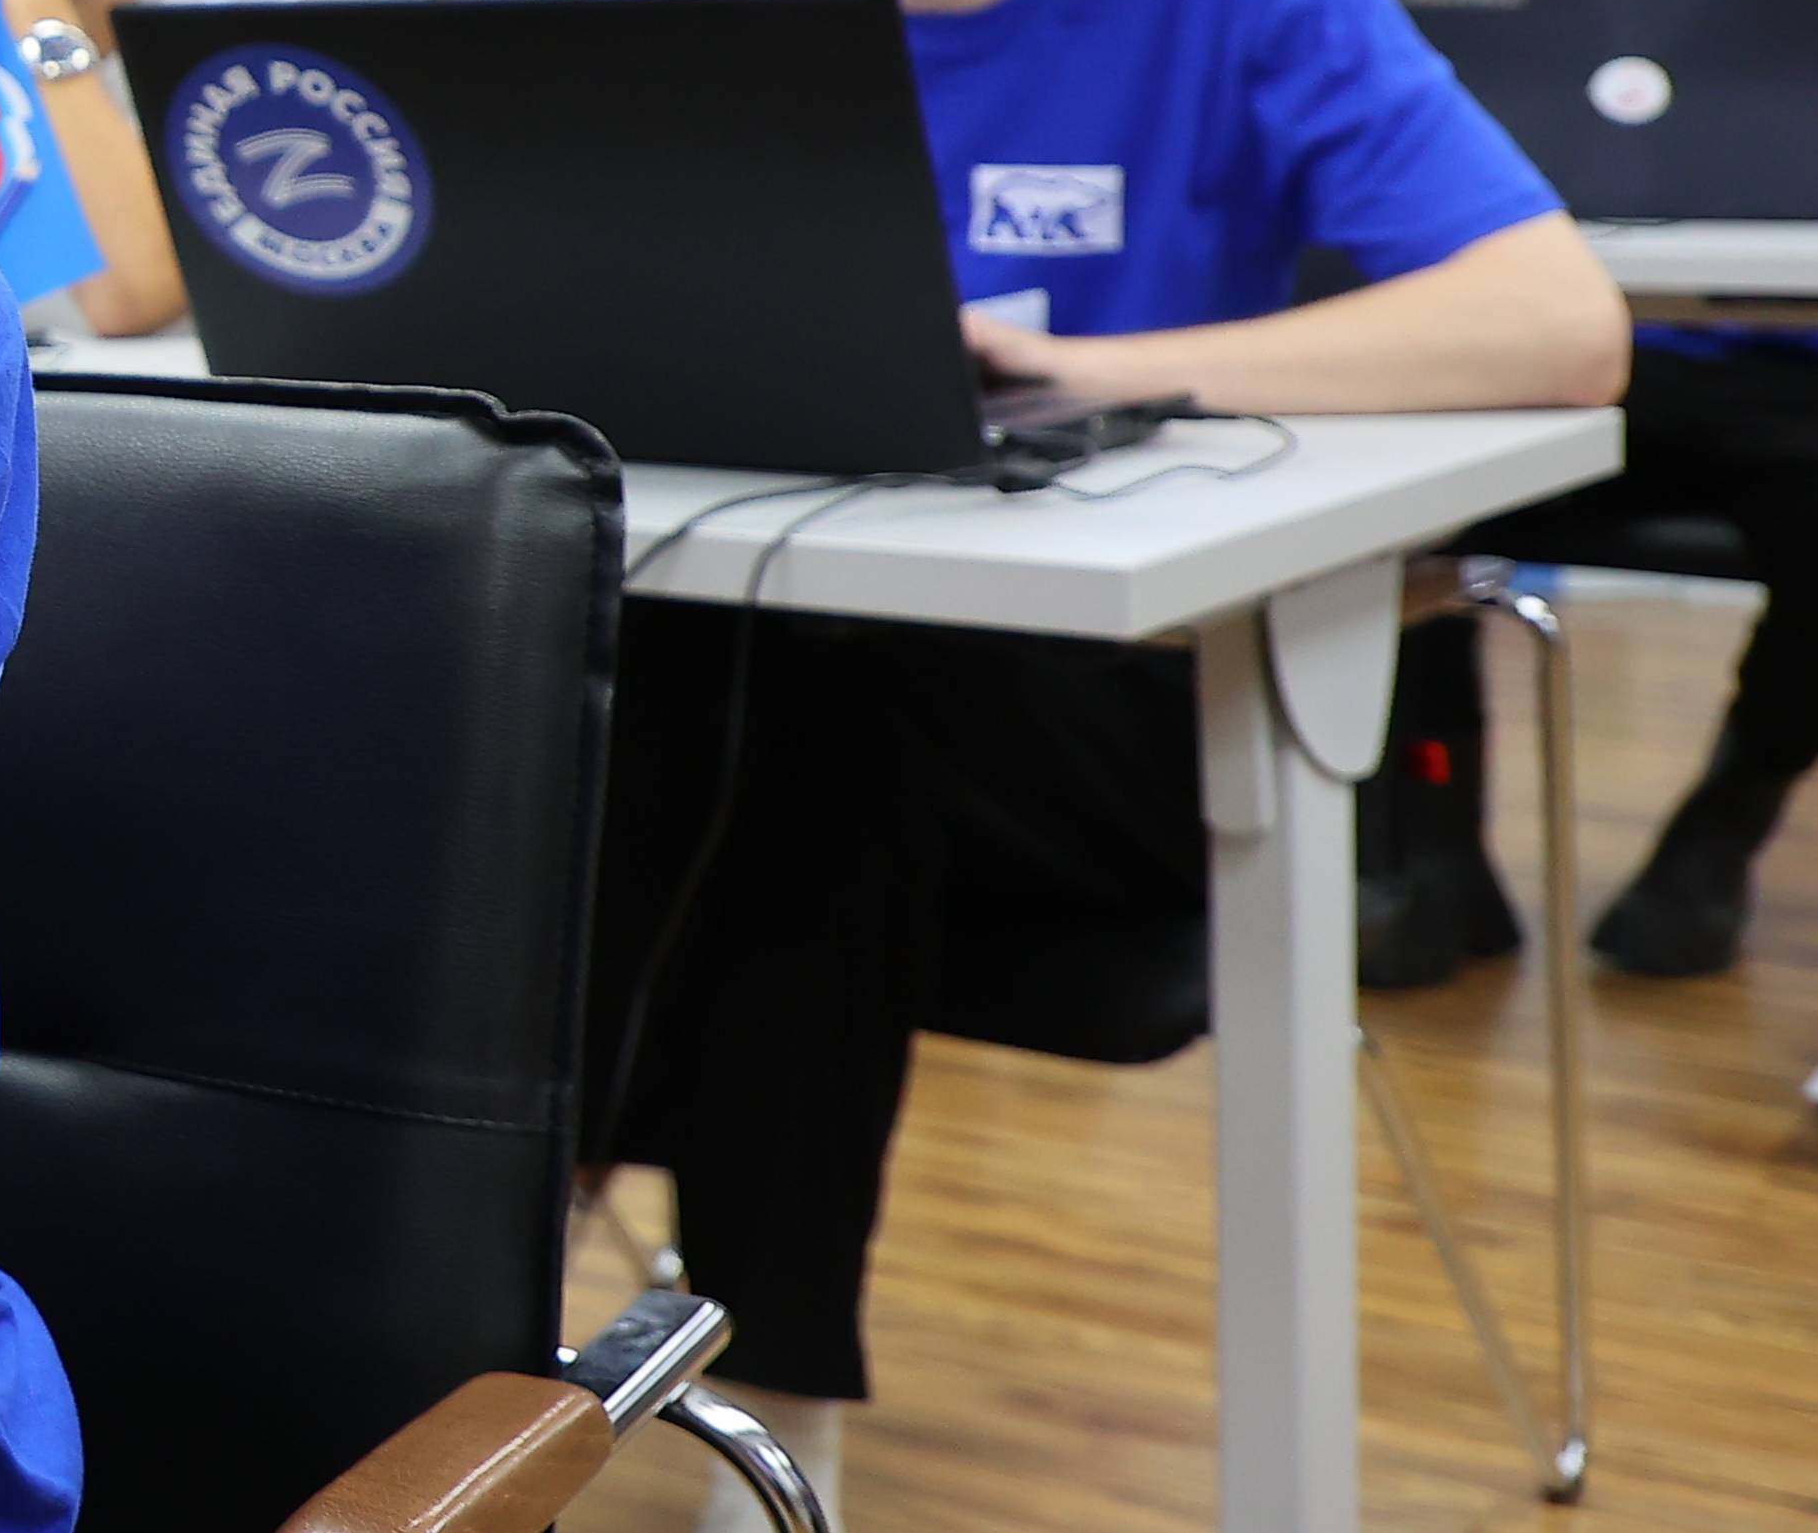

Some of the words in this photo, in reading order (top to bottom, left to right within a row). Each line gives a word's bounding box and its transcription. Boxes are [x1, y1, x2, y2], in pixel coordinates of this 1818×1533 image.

[183, 64, 261, 226] ЕДИНАЯ
[267, 59, 413, 203] РОССИЯ
[236, 127, 358, 211] Z
